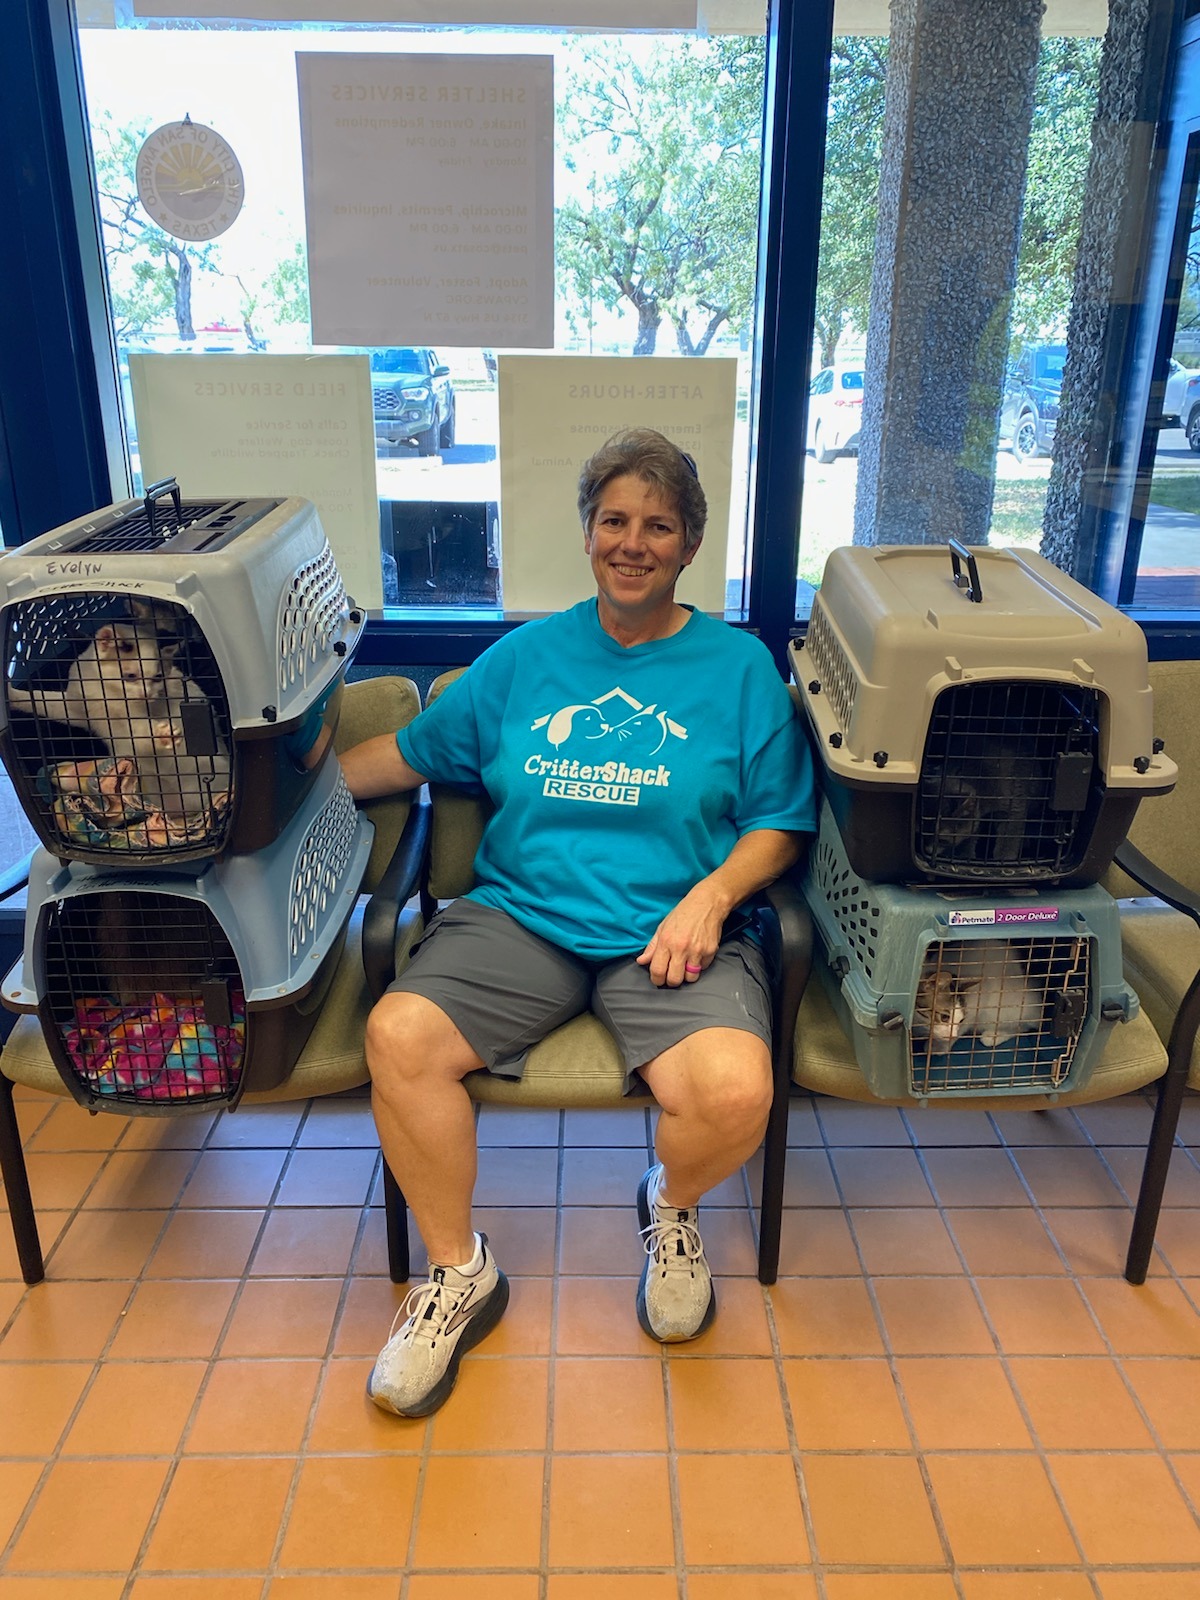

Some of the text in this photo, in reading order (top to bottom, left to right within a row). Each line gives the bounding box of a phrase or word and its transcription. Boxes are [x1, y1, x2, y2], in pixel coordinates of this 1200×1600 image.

[524, 754, 672, 787] CritterShack
[546, 781, 638, 803] RESCUE
[962, 916, 994, 924] Petmate
